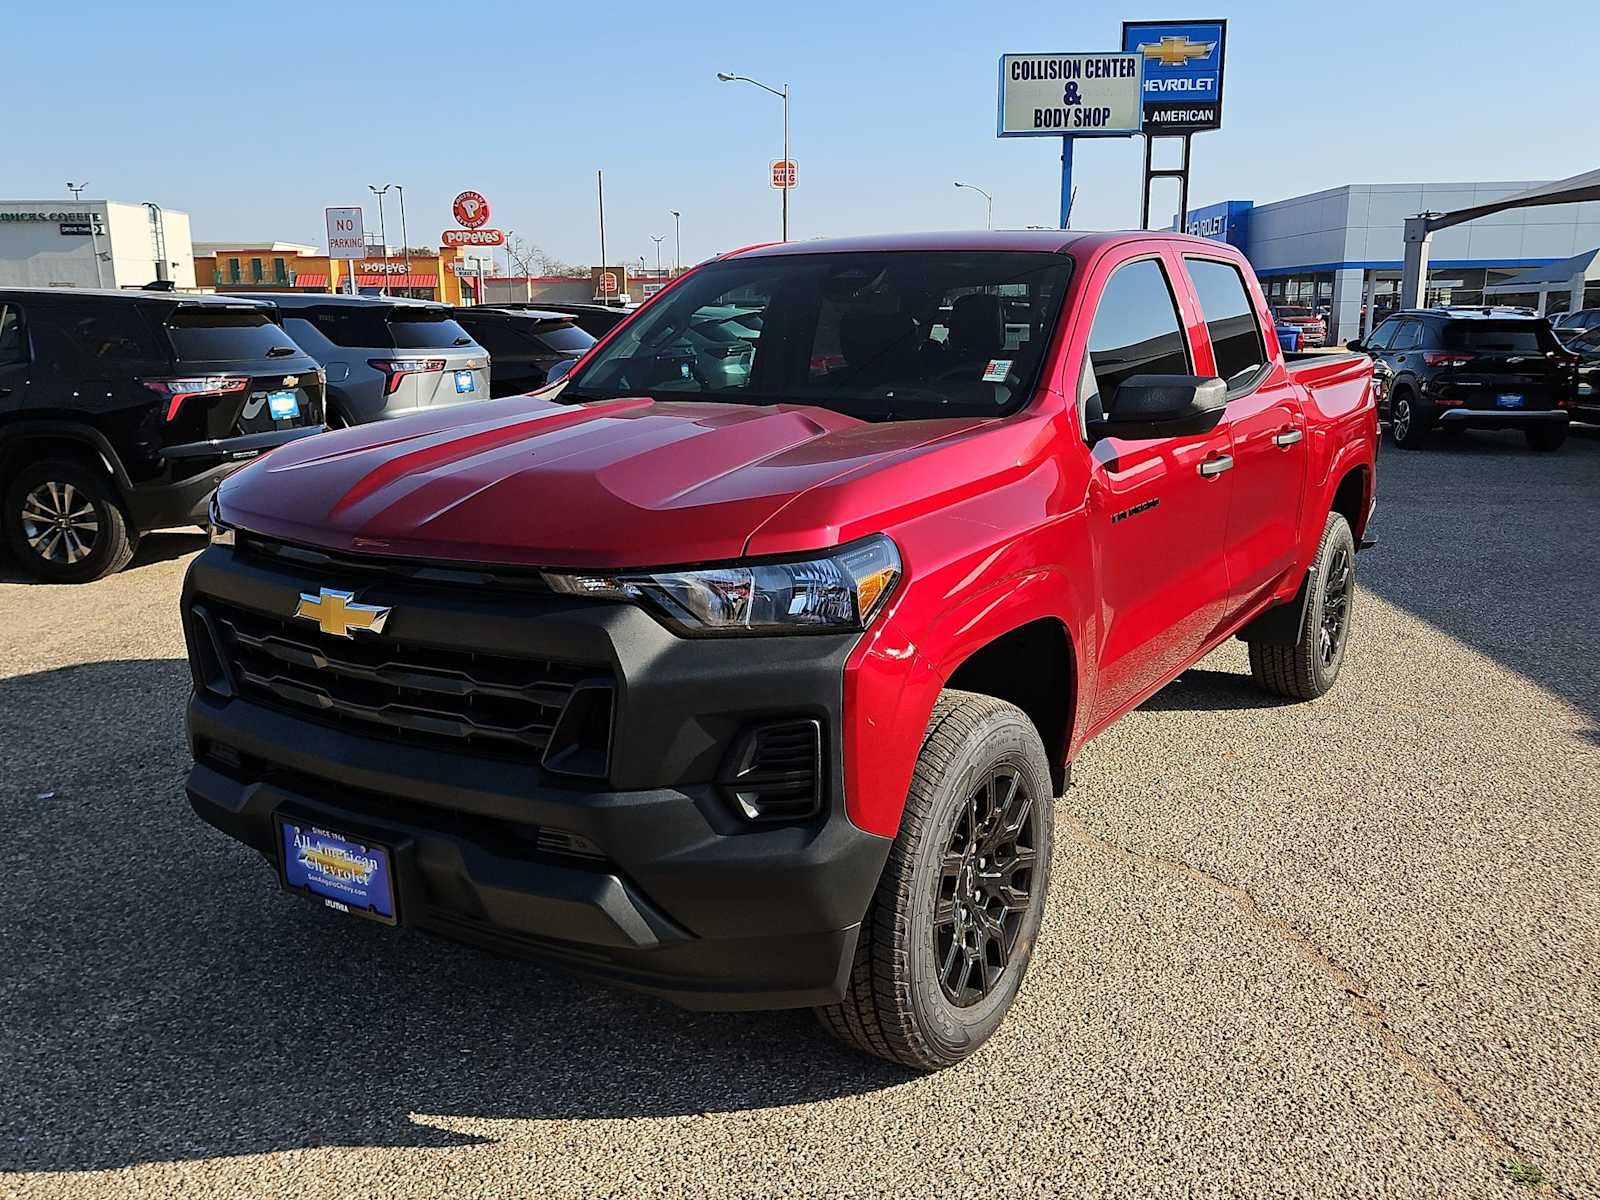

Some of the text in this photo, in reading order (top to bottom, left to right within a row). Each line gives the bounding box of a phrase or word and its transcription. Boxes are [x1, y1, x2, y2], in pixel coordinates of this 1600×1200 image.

[1011, 58, 1136, 81] COLLISION CENTER
[1063, 81, 1082, 106] &
[1143, 78, 1214, 92] HEVROLET
[1034, 107, 1111, 128] BODY SHOP
[1152, 109, 1214, 122] AMERICAN
[461, 199, 479, 218] P
[336, 219, 353, 231] NO
[1186, 215, 1223, 237] CHEVROLET
[330, 238, 363, 249] PARKING
[311, 826, 331, 839] SINCE
[293, 834, 378, 871] All American
[304, 856, 369, 886] Chevrolet
